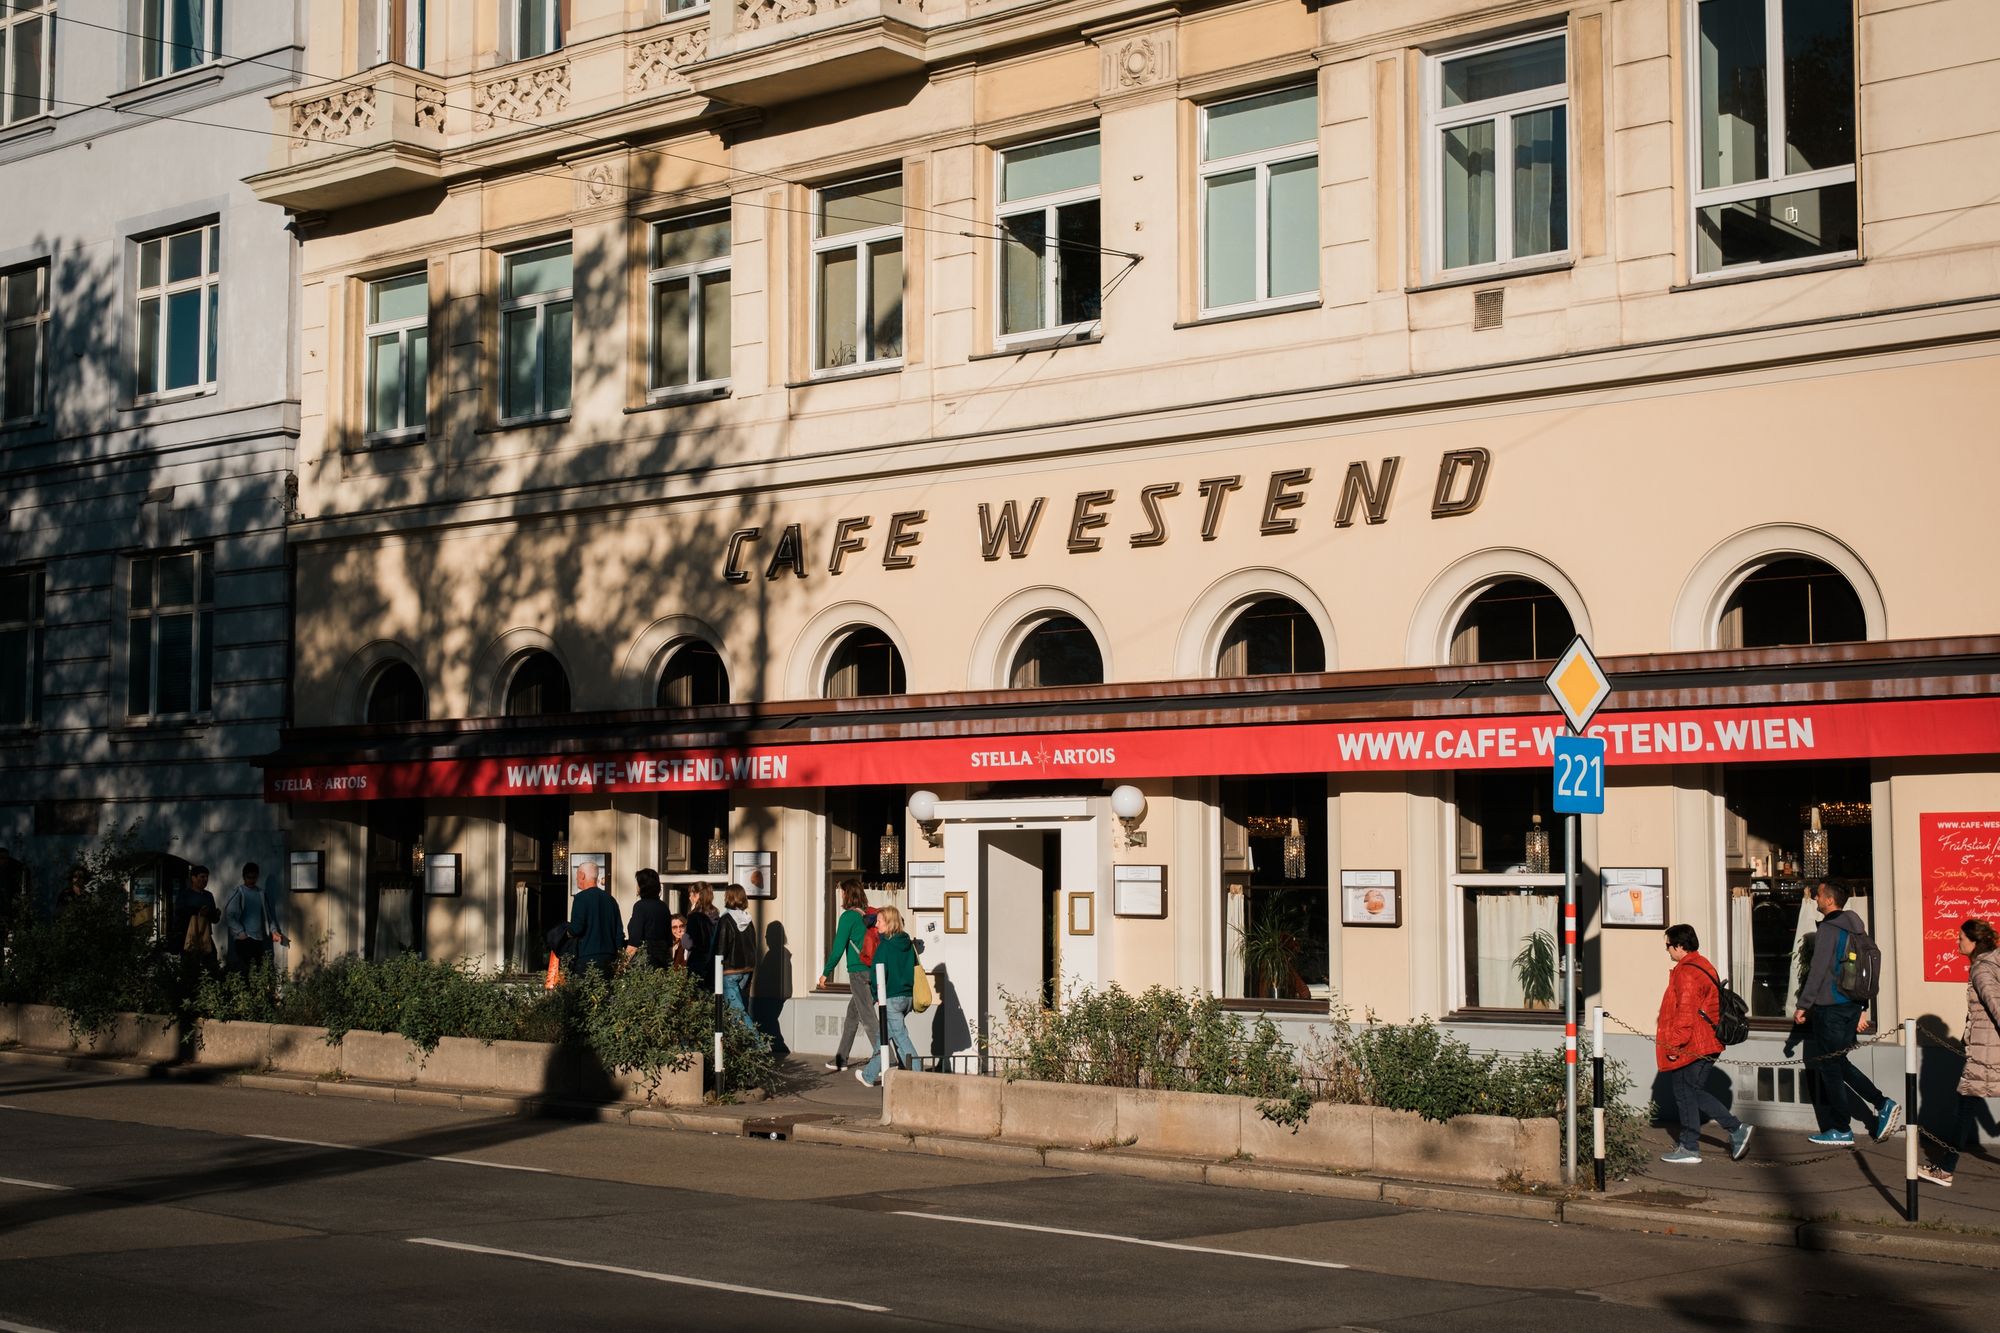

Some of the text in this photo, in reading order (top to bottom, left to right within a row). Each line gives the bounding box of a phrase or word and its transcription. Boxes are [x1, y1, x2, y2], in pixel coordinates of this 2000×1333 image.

[722, 446, 1493, 584] CAFE WESTEND
[971, 748, 1116, 767] STELLA ARTOIS
[1337, 716, 1815, 761] WWW.CAFE-WSTEND.WIEN
[274, 775, 367, 792] STELLA ARTOIS
[506, 754, 788, 788] WWW.CAFE-WESTEND.WIEN
[1557, 752, 1601, 798] 221
